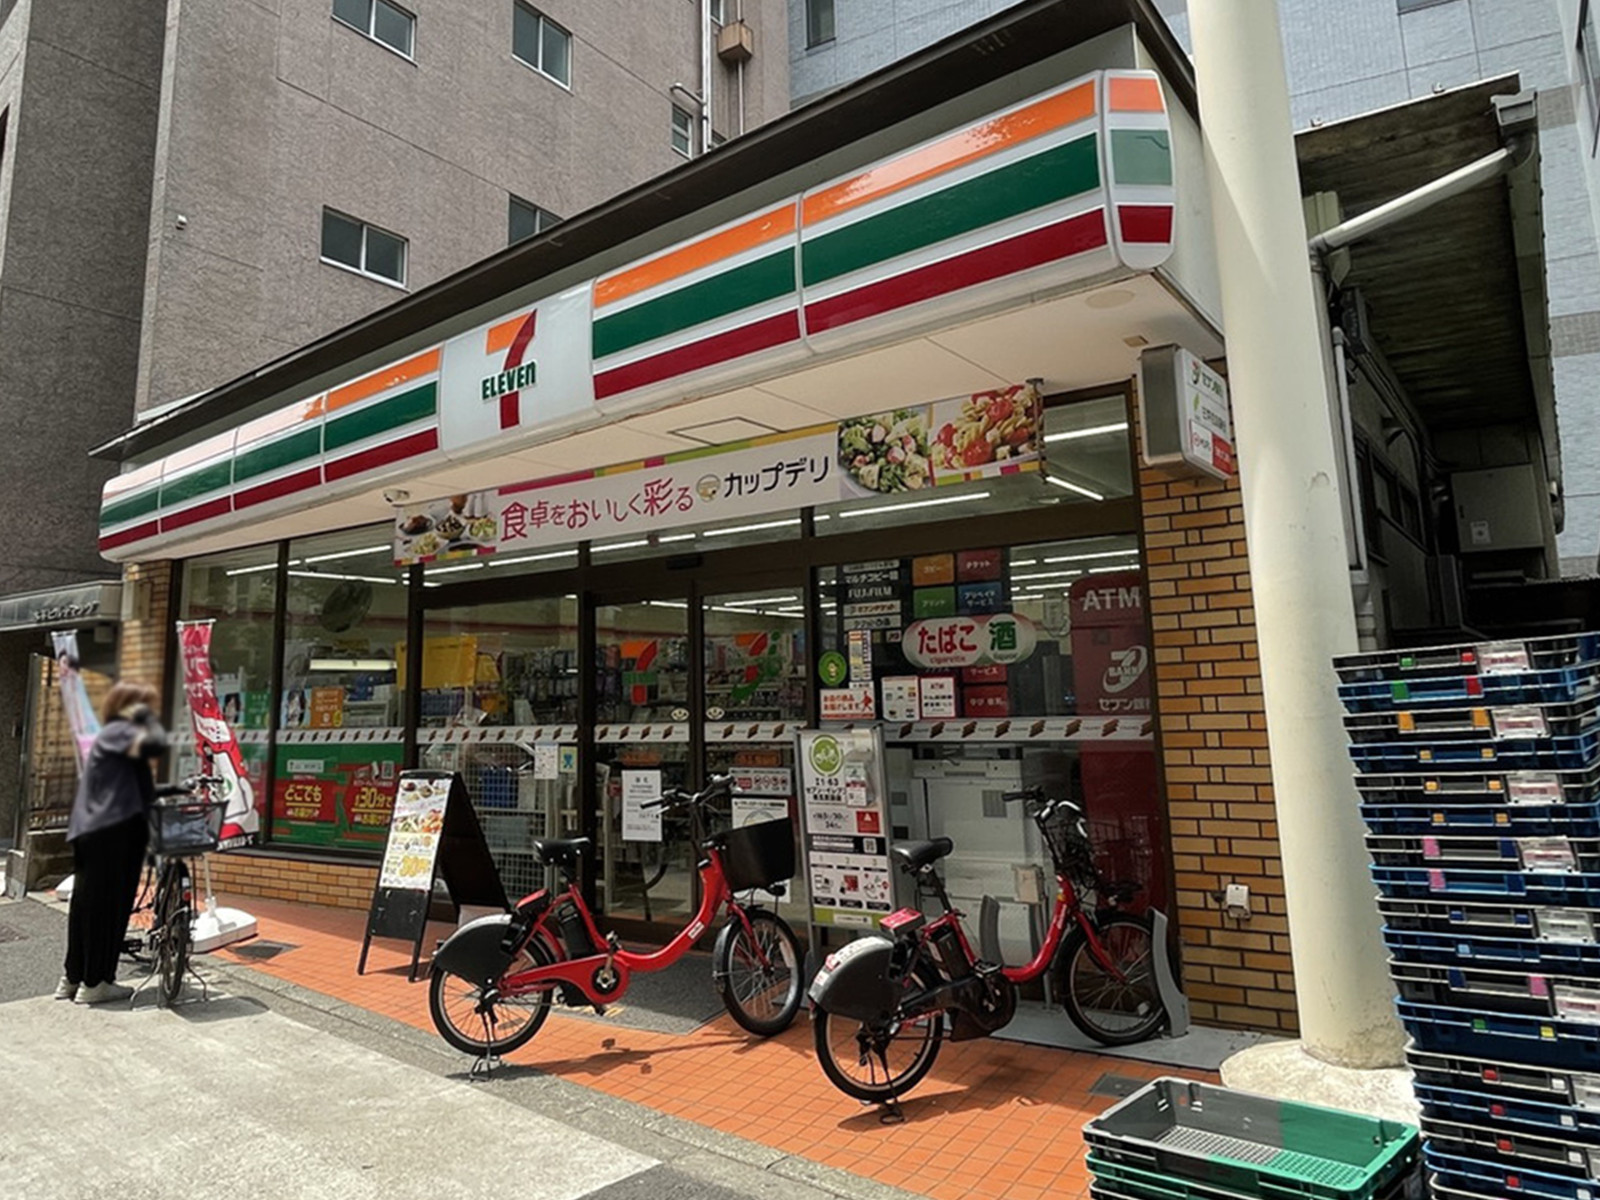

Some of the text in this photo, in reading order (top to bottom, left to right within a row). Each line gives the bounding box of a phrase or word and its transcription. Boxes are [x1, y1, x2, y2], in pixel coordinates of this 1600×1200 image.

[500, 455, 829, 542] 食卓をおいしく彩る カップデリ
[1083, 586, 1141, 612] ATM
[918, 622, 977, 655] たばこ
[989, 621, 1017, 651] 酒
[284, 783, 322, 802] どこでも
